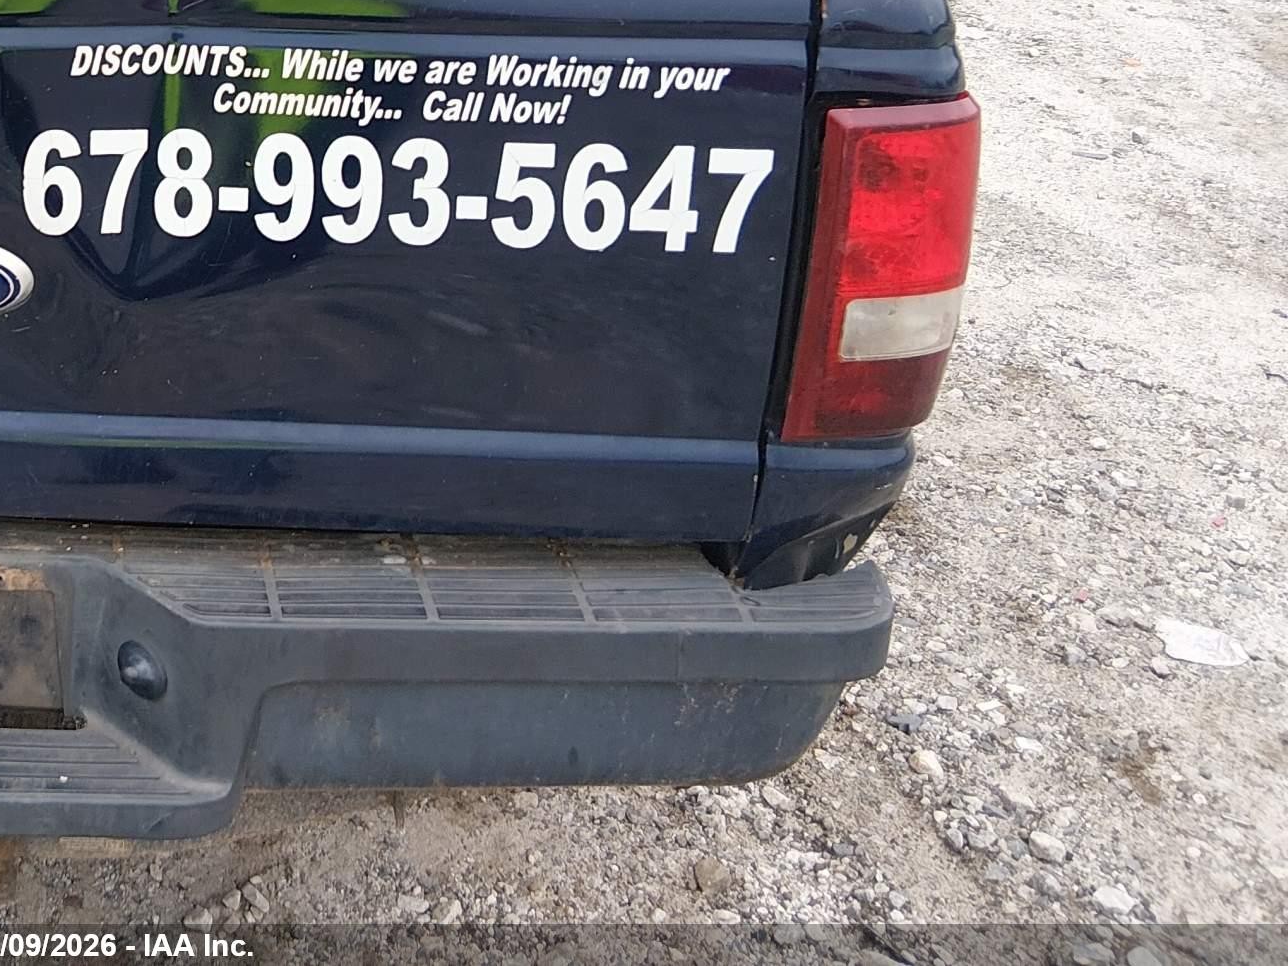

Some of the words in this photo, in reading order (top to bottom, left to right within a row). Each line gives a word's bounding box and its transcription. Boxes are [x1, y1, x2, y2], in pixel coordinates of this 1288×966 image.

[70, 44, 270, 79] DISCOUNTS...
[281, 48, 364, 82] While
[373, 58, 418, 84] we
[424, 59, 477, 85] are
[485, 55, 613, 97] Working
[618, 57, 650, 90] in
[653, 66, 731, 98] your
[213, 82, 403, 126] Community...
[422, 90, 485, 122] Call
[488, 92, 573, 125] Now!
[22, 128, 775, 253] 678-993-5647
